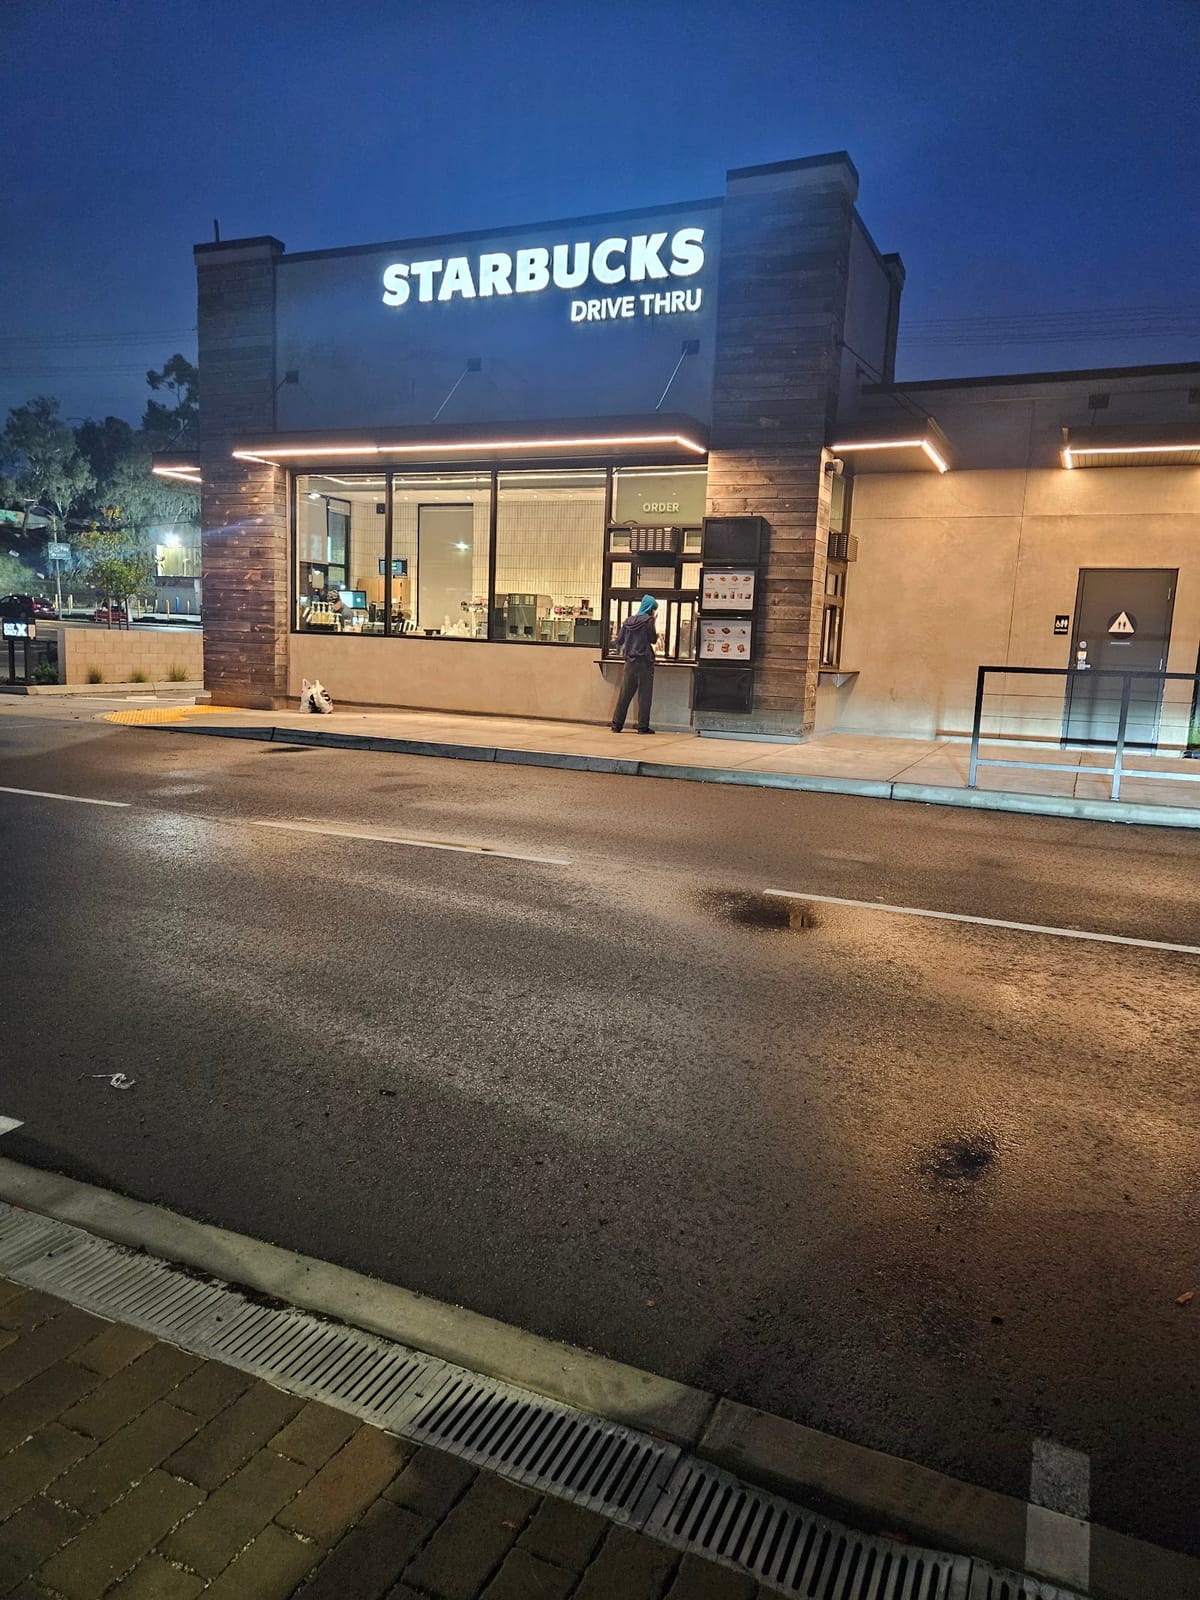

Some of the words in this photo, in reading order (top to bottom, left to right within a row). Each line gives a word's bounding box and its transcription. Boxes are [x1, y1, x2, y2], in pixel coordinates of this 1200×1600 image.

[382, 227, 706, 306] STARBUCKS
[570, 295, 635, 322] DRIVE
[640, 288, 702, 316] THRU
[642, 502, 680, 512] ORDER
